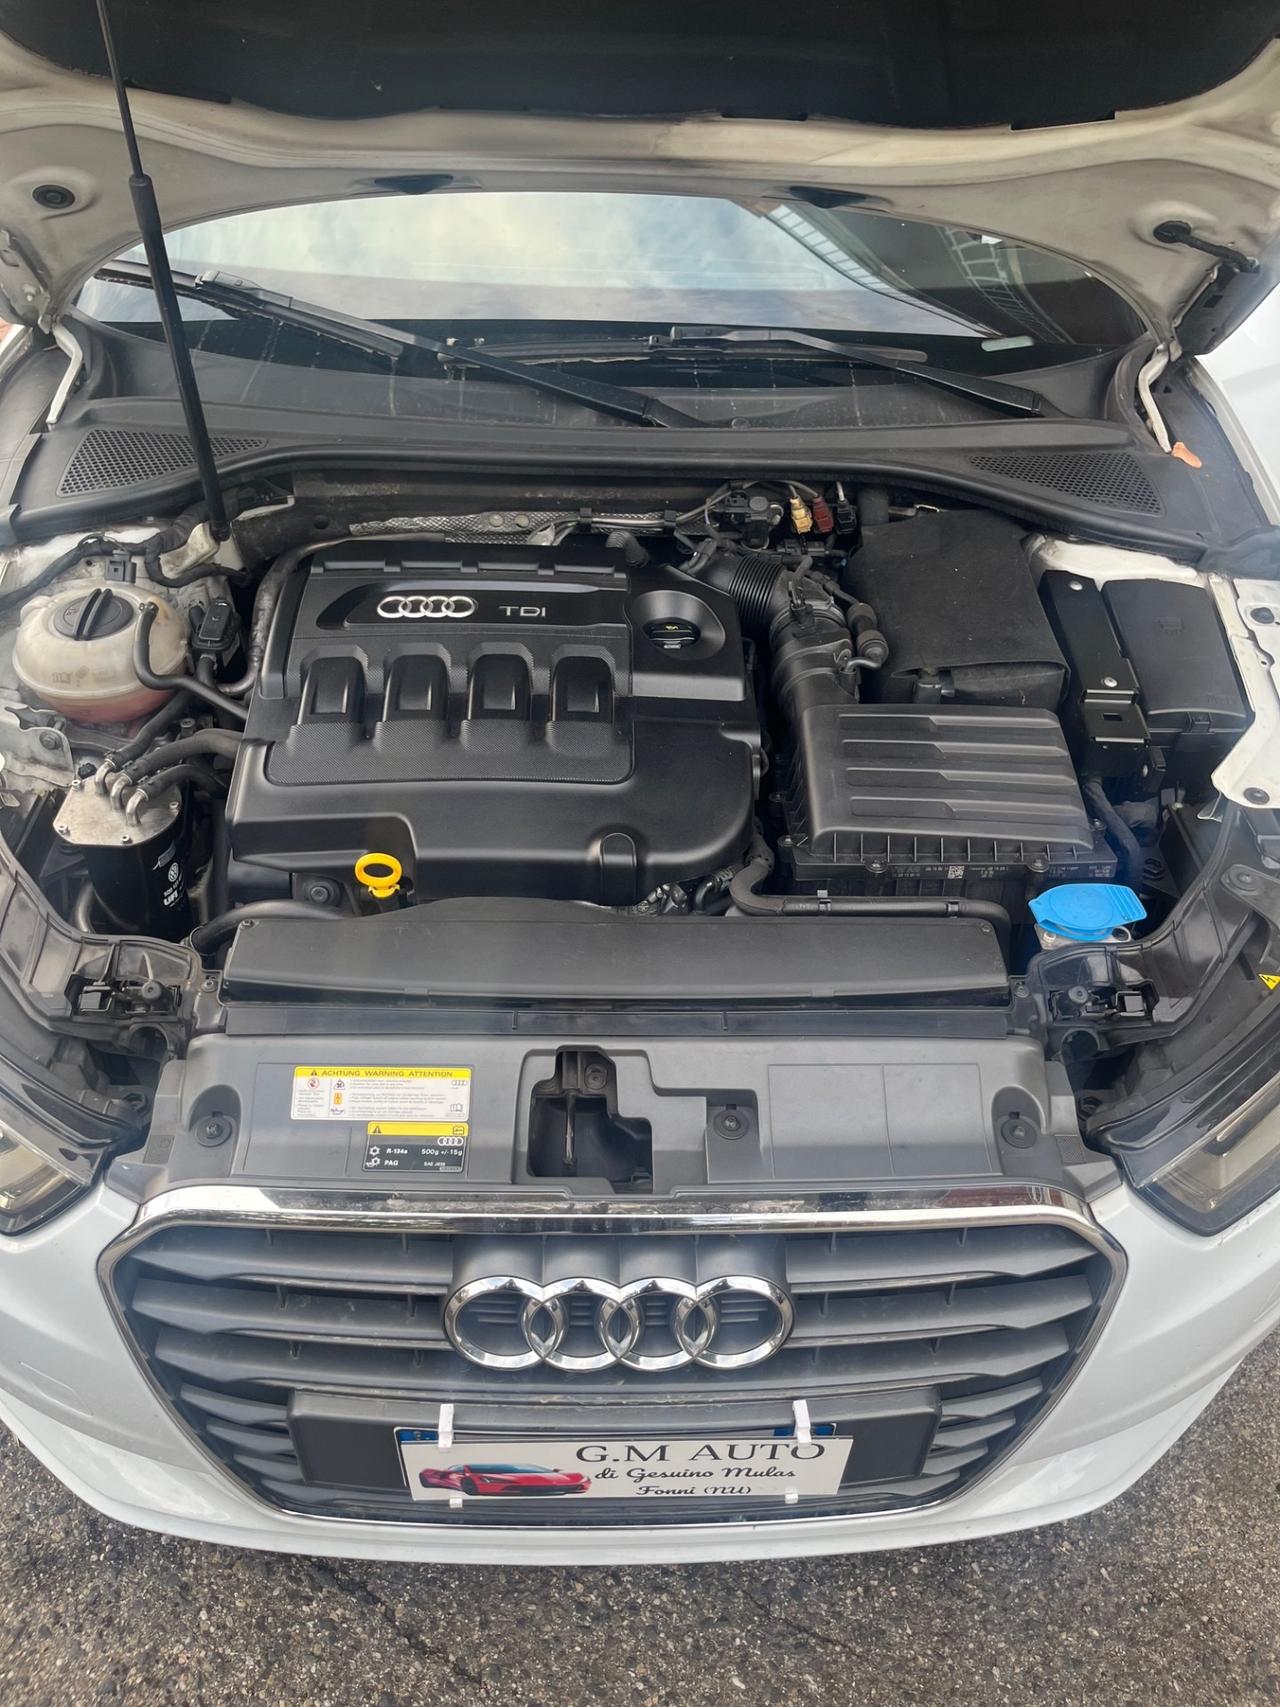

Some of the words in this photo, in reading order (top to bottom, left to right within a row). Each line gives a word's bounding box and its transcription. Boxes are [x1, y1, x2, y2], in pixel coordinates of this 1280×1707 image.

[499, 606, 546, 616] TDI
[364, 1070, 405, 1078] WARNING
[421, 1148, 440, 1156] 500g
[575, 1444, 670, 1463] G.M
[688, 1442, 826, 1461] AUTO
[594, 1467, 619, 1480] di
[626, 1467, 714, 1483] Gesuino
[720, 1466, 797, 1478] Mulas
[636, 1485, 696, 1496] Fonni
[703, 1485, 752, 1496] (NU)
